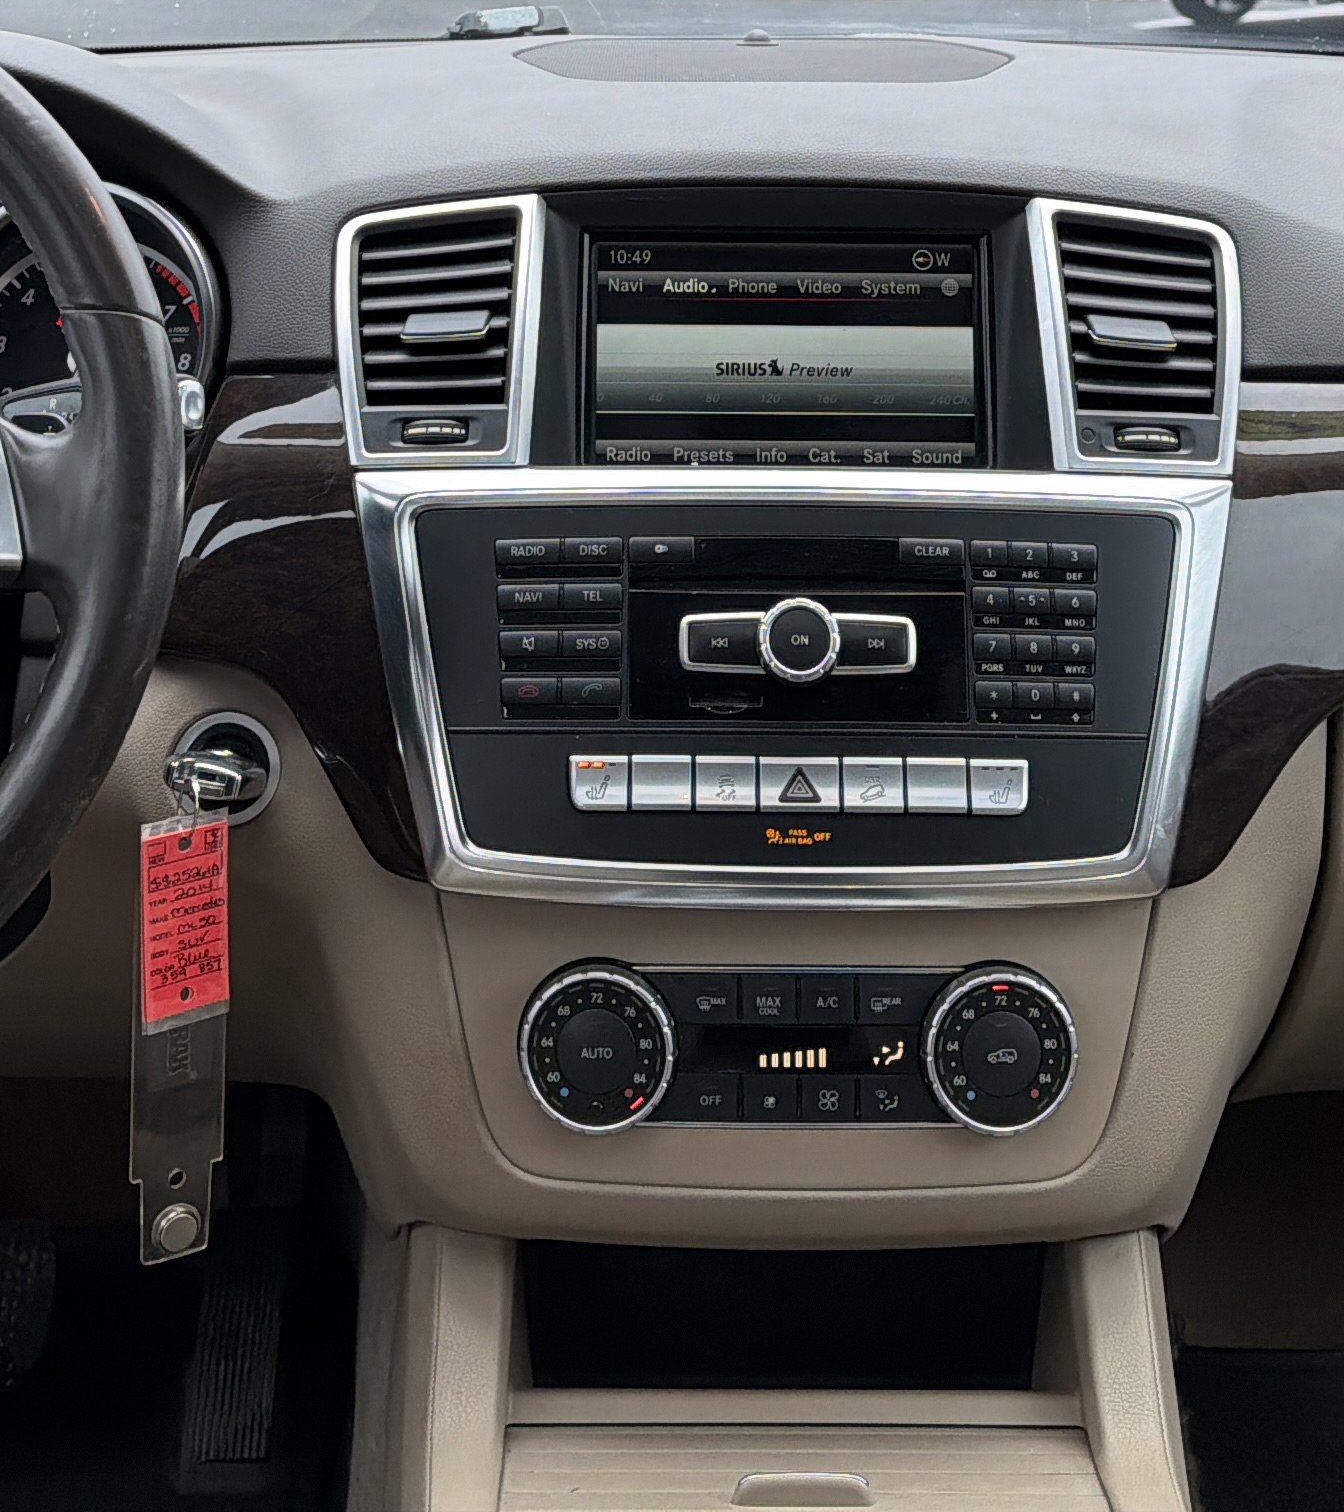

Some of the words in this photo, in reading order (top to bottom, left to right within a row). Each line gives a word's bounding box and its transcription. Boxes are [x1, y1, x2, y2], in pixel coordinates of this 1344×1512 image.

[608, 249, 652, 266] 10:49
[935, 252, 951, 267] W
[608, 278, 644, 293] Navi
[662, 278, 709, 294] Audio
[728, 279, 778, 294] Phone
[796, 279, 842, 295] Video
[861, 280, 921, 298] System
[21, 289, 35, 306] 4
[163, 305, 177, 322] 7
[177, 353, 192, 370] 8
[715, 362, 766, 377] SIRIUS
[789, 362, 853, 378] Preview
[606, 447, 651, 462] Radio
[673, 448, 734, 464] Presets
[756, 448, 787, 464] Info
[808, 448, 841, 464] Cat.
[863, 449, 890, 465] Sat
[911, 449, 963, 465] Sound
[511, 545, 546, 557] RADIO
[579, 544, 608, 556] DISC
[914, 545, 950, 557] CLEAR
[986, 548, 992, 558] 1
[1026, 550, 1034, 561] 2
[1070, 551, 1079, 562] 3
[1021, 570, 1040, 579] ABC
[1066, 572, 1083, 581] DEF
[514, 591, 543, 603] NAVI
[582, 590, 604, 602] TEL
[986, 594, 994, 605] 4
[1028, 595, 1036, 606] 5
[1071, 596, 1080, 608] 6
[983, 616, 1000, 625] GHI
[1024, 618, 1041, 626] JKL
[1064, 619, 1086, 627] MNO
[576, 638, 597, 650] SYS
[791, 634, 809, 646] ON
[988, 641, 997, 652] 7
[1029, 642, 1038, 653] 8
[1071, 643, 1080, 654] 9
[1024, 664, 1044, 673] TUV
[1064, 665, 1087, 674] WXYZ
[721, 793, 737, 802] OFF
[788, 829, 809, 837] PASS
[814, 832, 832, 842] OFF
[784, 837, 797, 845] AIR
[797, 837, 814, 845] BAG
[173, 879, 213, 900] 2014
[590, 993, 604, 1003] 72
[710, 997, 727, 1006] MAX
[756, 996, 782, 1007] MAX
[816, 996, 839, 1008] A/C
[882, 997, 902, 1006] REAR
[994, 996, 1008, 1006] 72
[557, 1006, 571, 1016] 68
[624, 1006, 637, 1017] 76
[759, 1007, 780, 1016] COOL
[962, 1009, 975, 1019] 68
[1027, 1008, 1040, 1019] 76
[540, 1037, 554, 1047] 64
[639, 1039, 653, 1049] 80
[946, 1040, 959, 1051] 64
[1043, 1039, 1057, 1050] 80
[580, 1047, 613, 1059] AUTO
[547, 1071, 561, 1082] 60
[633, 1073, 647, 1084] 84
[953, 1076, 966, 1086] 60
[1039, 1074, 1052, 1084] 84
[700, 1095, 723, 1106] OFF
